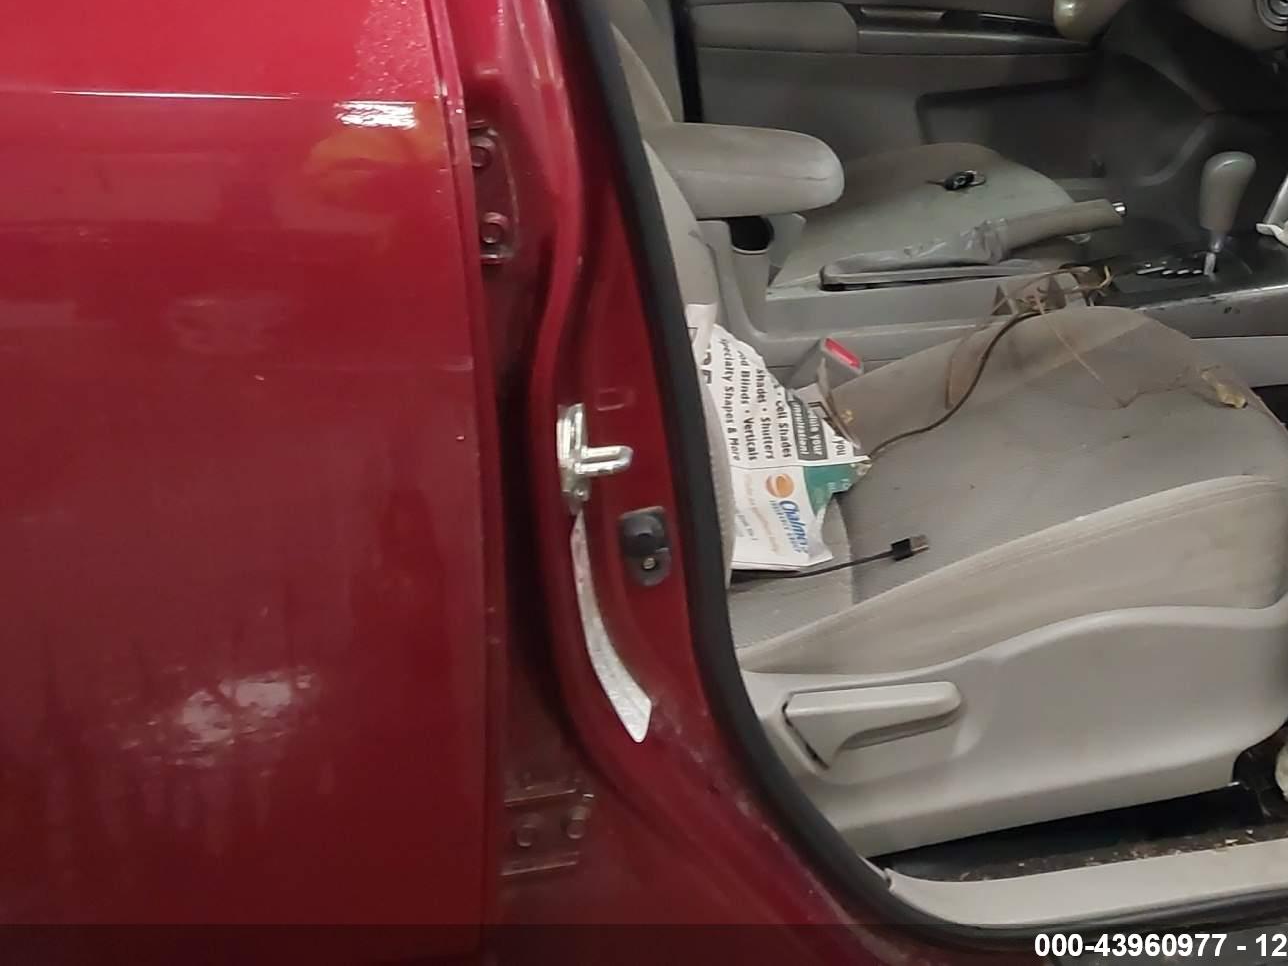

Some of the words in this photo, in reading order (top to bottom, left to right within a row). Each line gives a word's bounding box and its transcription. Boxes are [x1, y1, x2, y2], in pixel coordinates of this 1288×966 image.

[721, 386, 735, 423] Shapes
[741, 370, 751, 405] Blinds
[743, 418, 759, 461] Verticals
[760, 417, 775, 460] Shutters
[778, 423, 793, 458] Shades
[809, 432, 823, 455] your
[832, 438, 847, 455] you
